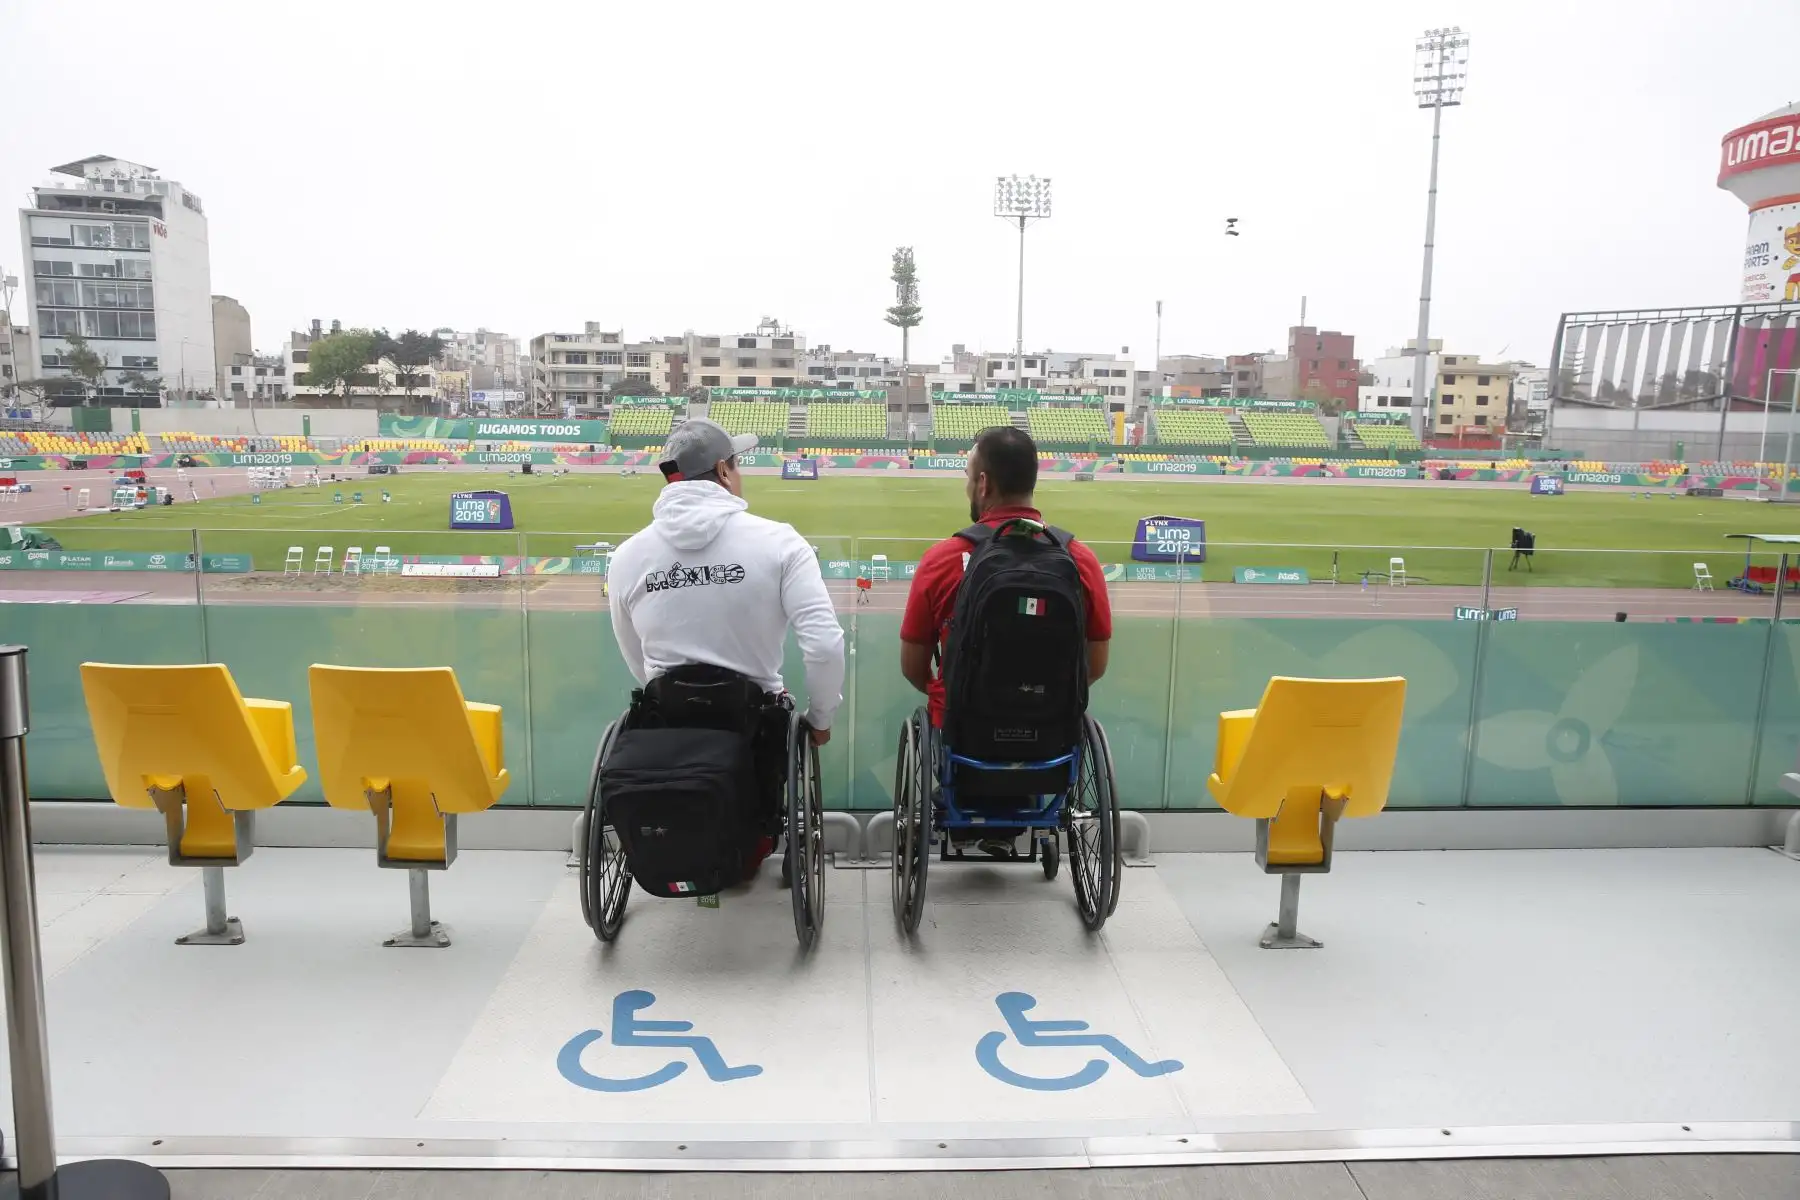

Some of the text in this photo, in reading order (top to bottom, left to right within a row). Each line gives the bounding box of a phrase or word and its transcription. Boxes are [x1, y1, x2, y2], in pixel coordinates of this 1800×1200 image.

[1728, 126, 1800, 166] Lima
[477, 423, 581, 436] JUGAMOS TODOS
[455, 510, 485, 521] 2019
[1157, 540, 1190, 553] 2019
